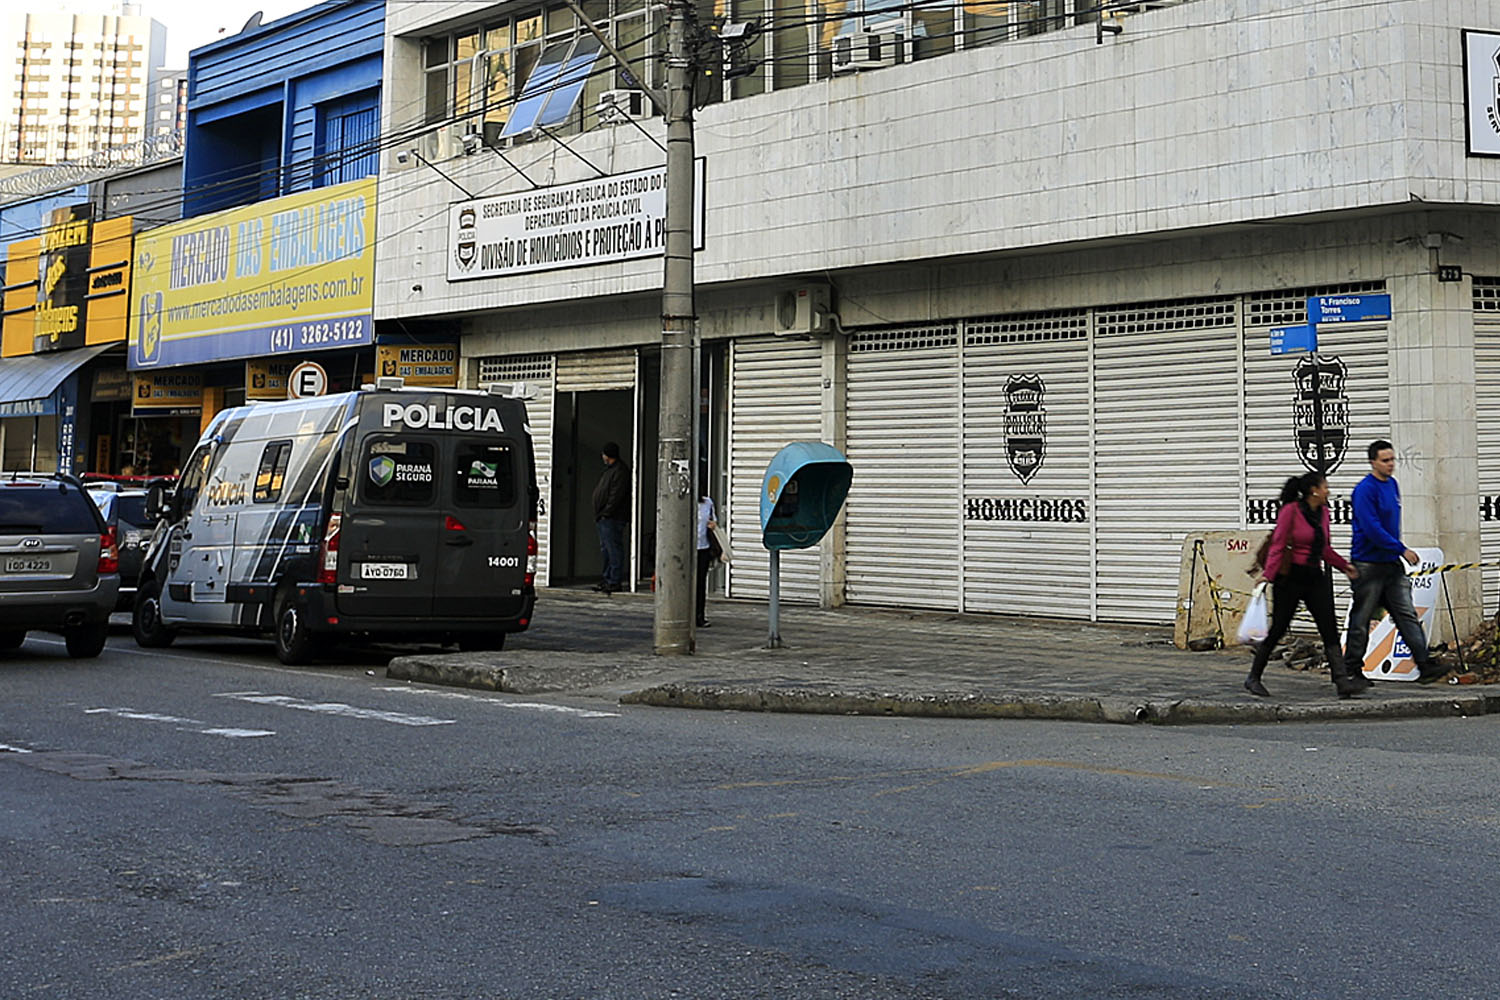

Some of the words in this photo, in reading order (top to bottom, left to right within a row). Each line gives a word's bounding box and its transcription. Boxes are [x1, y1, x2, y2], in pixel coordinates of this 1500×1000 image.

[483, 203, 521, 219] SECRETARIA
[523, 197, 532, 212] DE
[533, 190, 574, 211] SEGURANÇA
[575, 184, 606, 205] PÚBLICA
[607, 181, 618, 198] DO
[619, 177, 649, 196] ESTADO
[650, 175, 661, 191] DO
[525, 208, 579, 231] DEPARTAMENTO
[580, 209, 591, 222] DA
[591, 202, 621, 221] POLÍCIA
[622, 198, 642, 216] CIVIL
[169, 225, 231, 290] MERCADO
[235, 217, 263, 278] DAS
[269, 195, 367, 272] EMBALAGENS
[481, 237, 514, 271] DIVISÃO
[516, 239, 527, 267] DE
[529, 229, 583, 265] HOMICÍDIOS
[585, 231, 591, 258] E
[592, 218, 642, 257] PROTEÇÃO
[644, 215, 651, 244] À
[167, 272, 365, 323] www.mercadodasembalagens.com.br
[1321, 306, 1342, 314] Torres
[1328, 297, 1360, 305] Francisco
[270, 327, 294, 352] (41)
[301, 319, 363, 345] 3262-5122
[400, 349, 455, 362] MERCADO
[153, 375, 200, 386] MERCADO
[300, 371, 317, 396] E
[383, 403, 505, 432] POLÍCIA
[396, 463, 432, 473] PARANÁ
[396, 473, 432, 482] SEGURO
[966, 494, 1088, 523] HOMICÍDIOS
[488, 557, 519, 567] 14001
